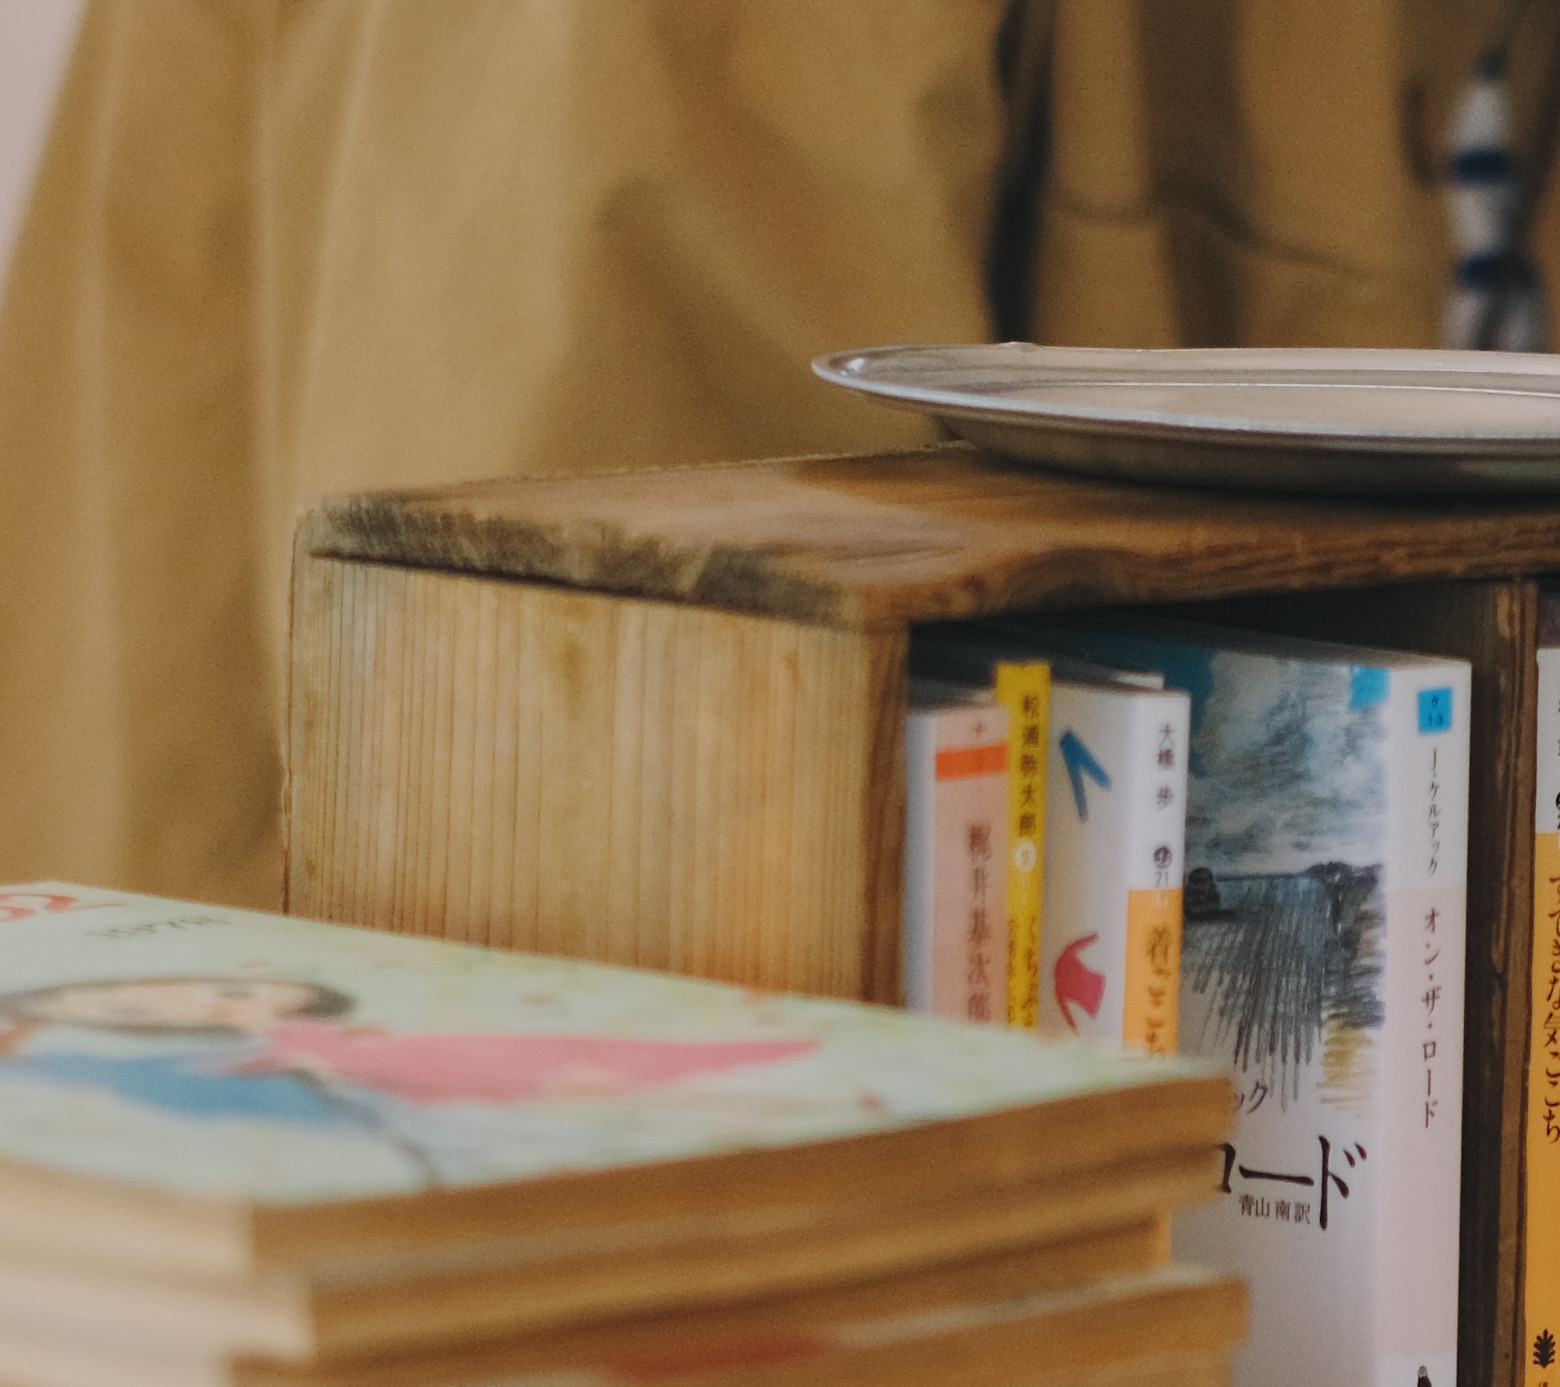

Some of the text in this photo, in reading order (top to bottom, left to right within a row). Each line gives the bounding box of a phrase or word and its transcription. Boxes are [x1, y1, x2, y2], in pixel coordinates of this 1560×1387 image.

[1422, 906, 1441, 1130] オン・ザ・ロード
